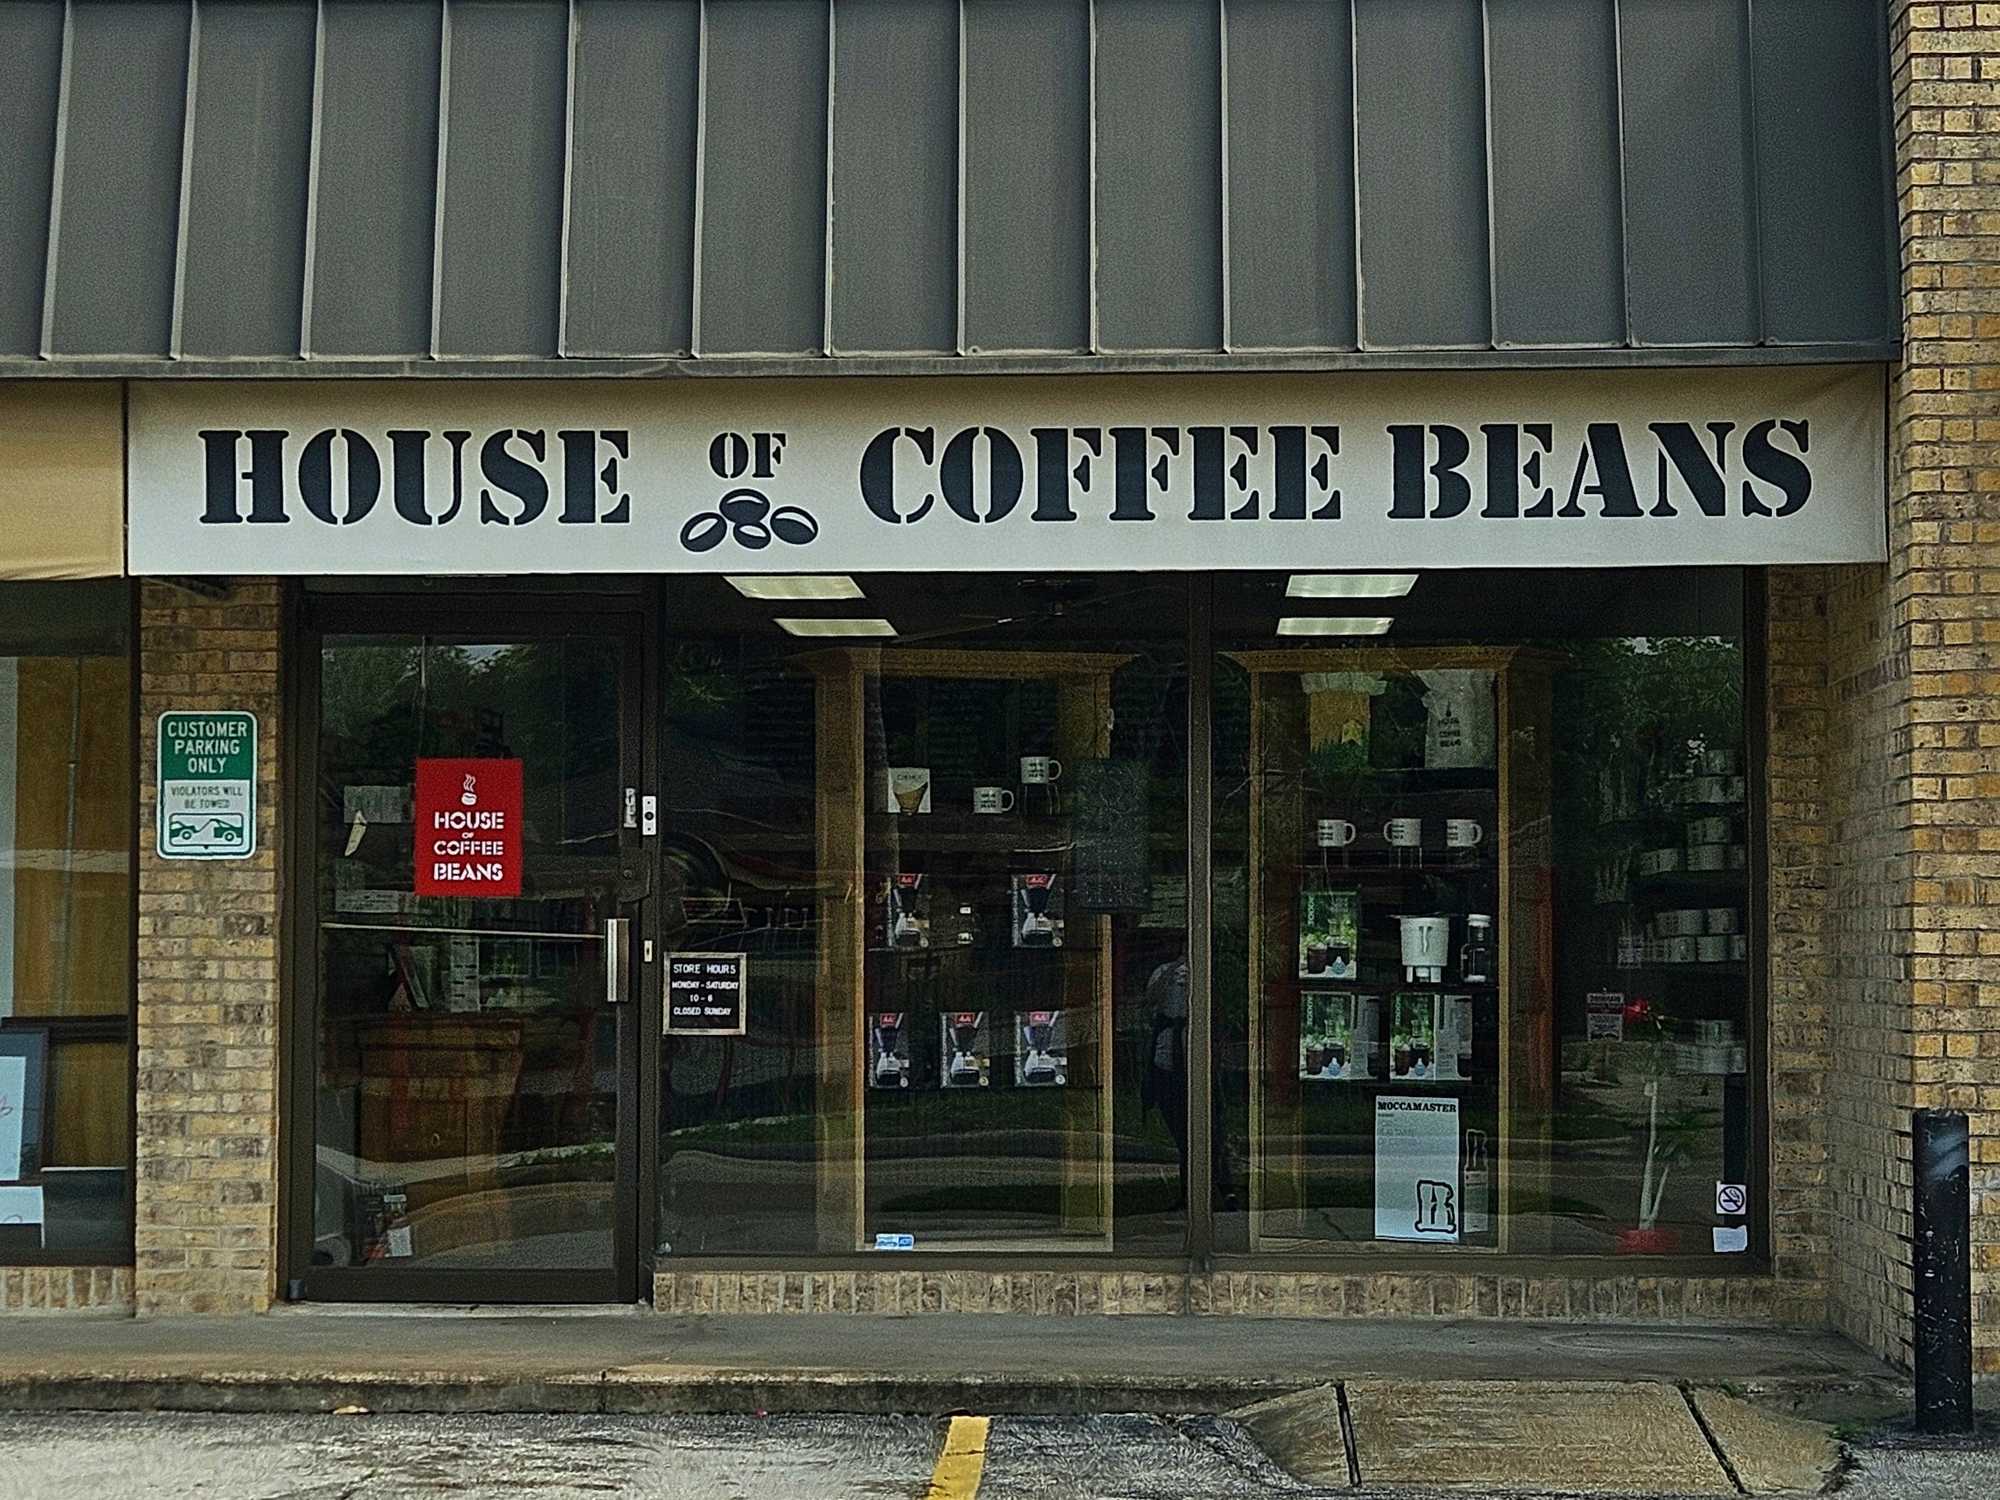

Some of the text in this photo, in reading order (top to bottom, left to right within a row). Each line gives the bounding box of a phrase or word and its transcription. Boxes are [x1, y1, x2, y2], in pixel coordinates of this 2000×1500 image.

[198, 418, 1812, 526] HOUSE OF COFFEE BEANS
[167, 721, 247, 737] CUSTOMER
[174, 739, 240, 755] PARKING
[188, 757, 227, 773] ONLY
[171, 785, 243, 796] VIOLATORS WILL
[199, 799, 230, 809] TOWED
[434, 811, 505, 830] HOUSE
[461, 831, 475, 840] OF
[433, 840, 504, 856] COFFEE
[433, 862, 504, 881] BEANS
[673, 963, 737, 975] STORE HOURS
[671, 980, 700, 990] MONDAY
[705, 980, 739, 990] SATURDAY
[689, 994, 700, 1003] 10
[673, 1006, 732, 1016] CLOSED SUNDAY
[1377, 1101, 1457, 1113] MOCCAMASTER
